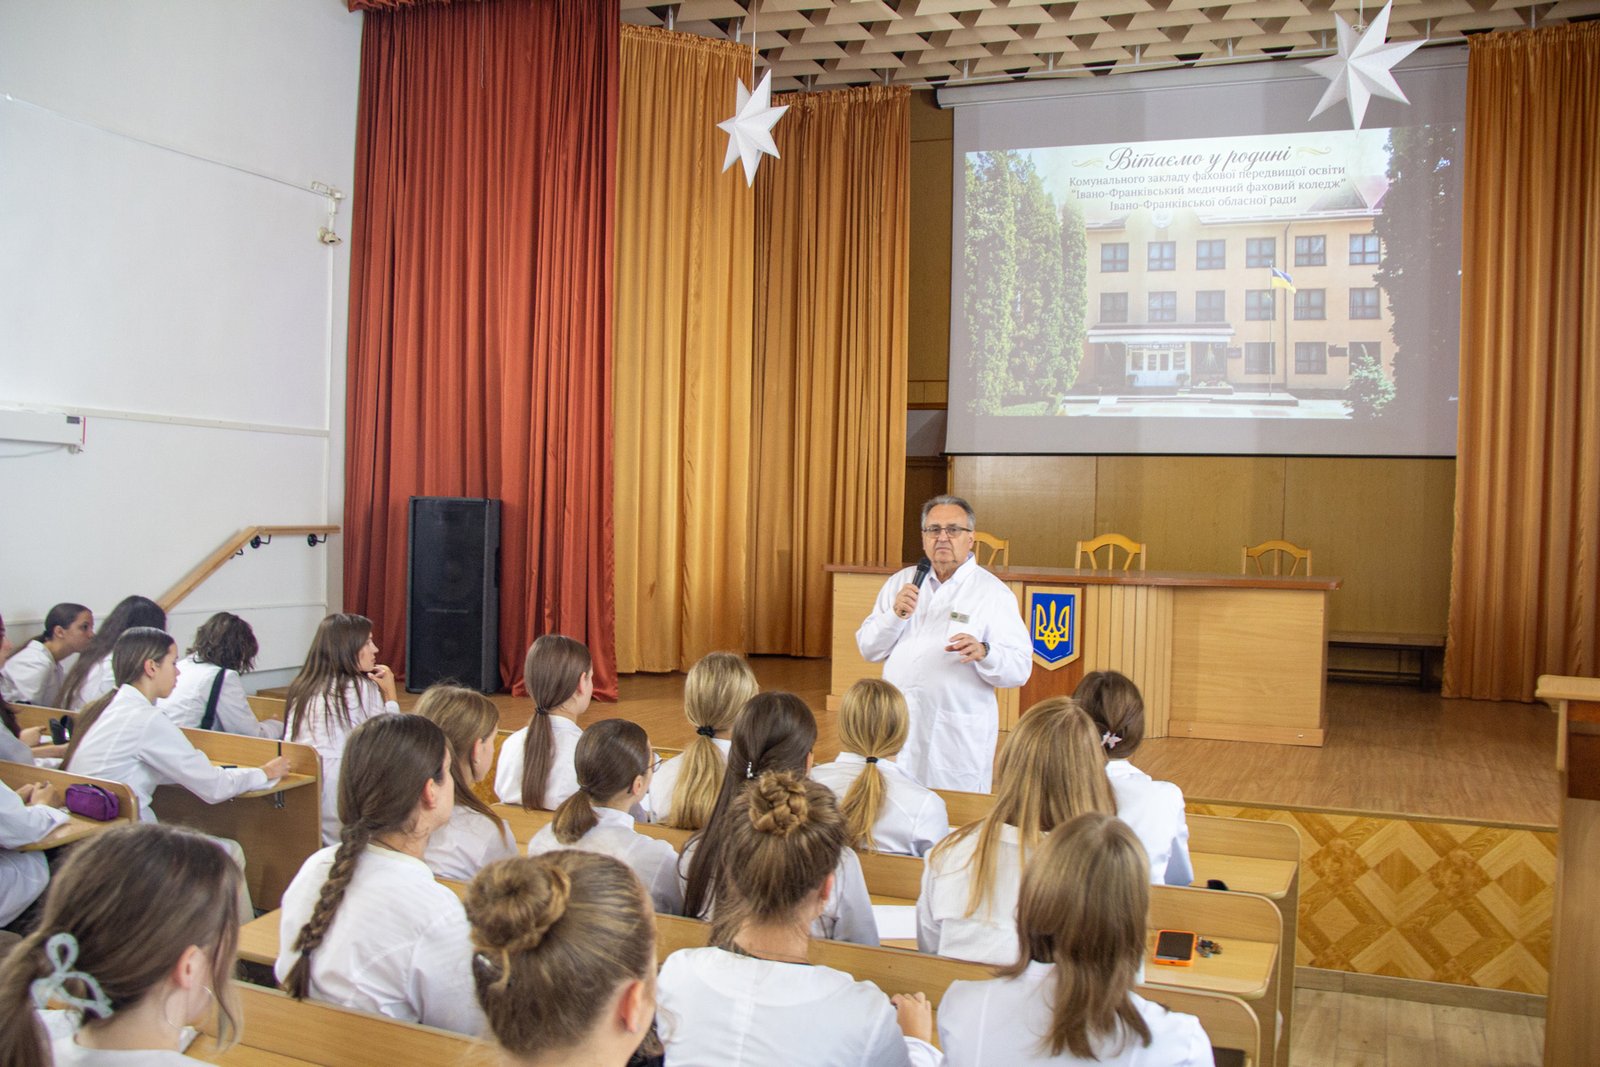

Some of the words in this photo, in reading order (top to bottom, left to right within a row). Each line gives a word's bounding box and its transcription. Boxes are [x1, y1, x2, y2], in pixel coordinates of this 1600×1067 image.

[1105, 146, 1204, 170] Вітаємо
[1206, 153, 1221, 172] у
[1221, 146, 1291, 171] родині
[1069, 175, 1145, 187] Комунального
[1148, 173, 1190, 183] закладу
[1192, 169, 1235, 181] фахової
[1238, 166, 1305, 180] передвищої
[1309, 165, 1345, 175] освіти
[1187, 183, 1244, 194] медичний
[1246, 181, 1295, 194] фаховий
[1110, 198, 1215, 211] Івано-Франківської
[1218, 196, 1266, 207] обласної
[1270, 196, 1297, 207] ради
